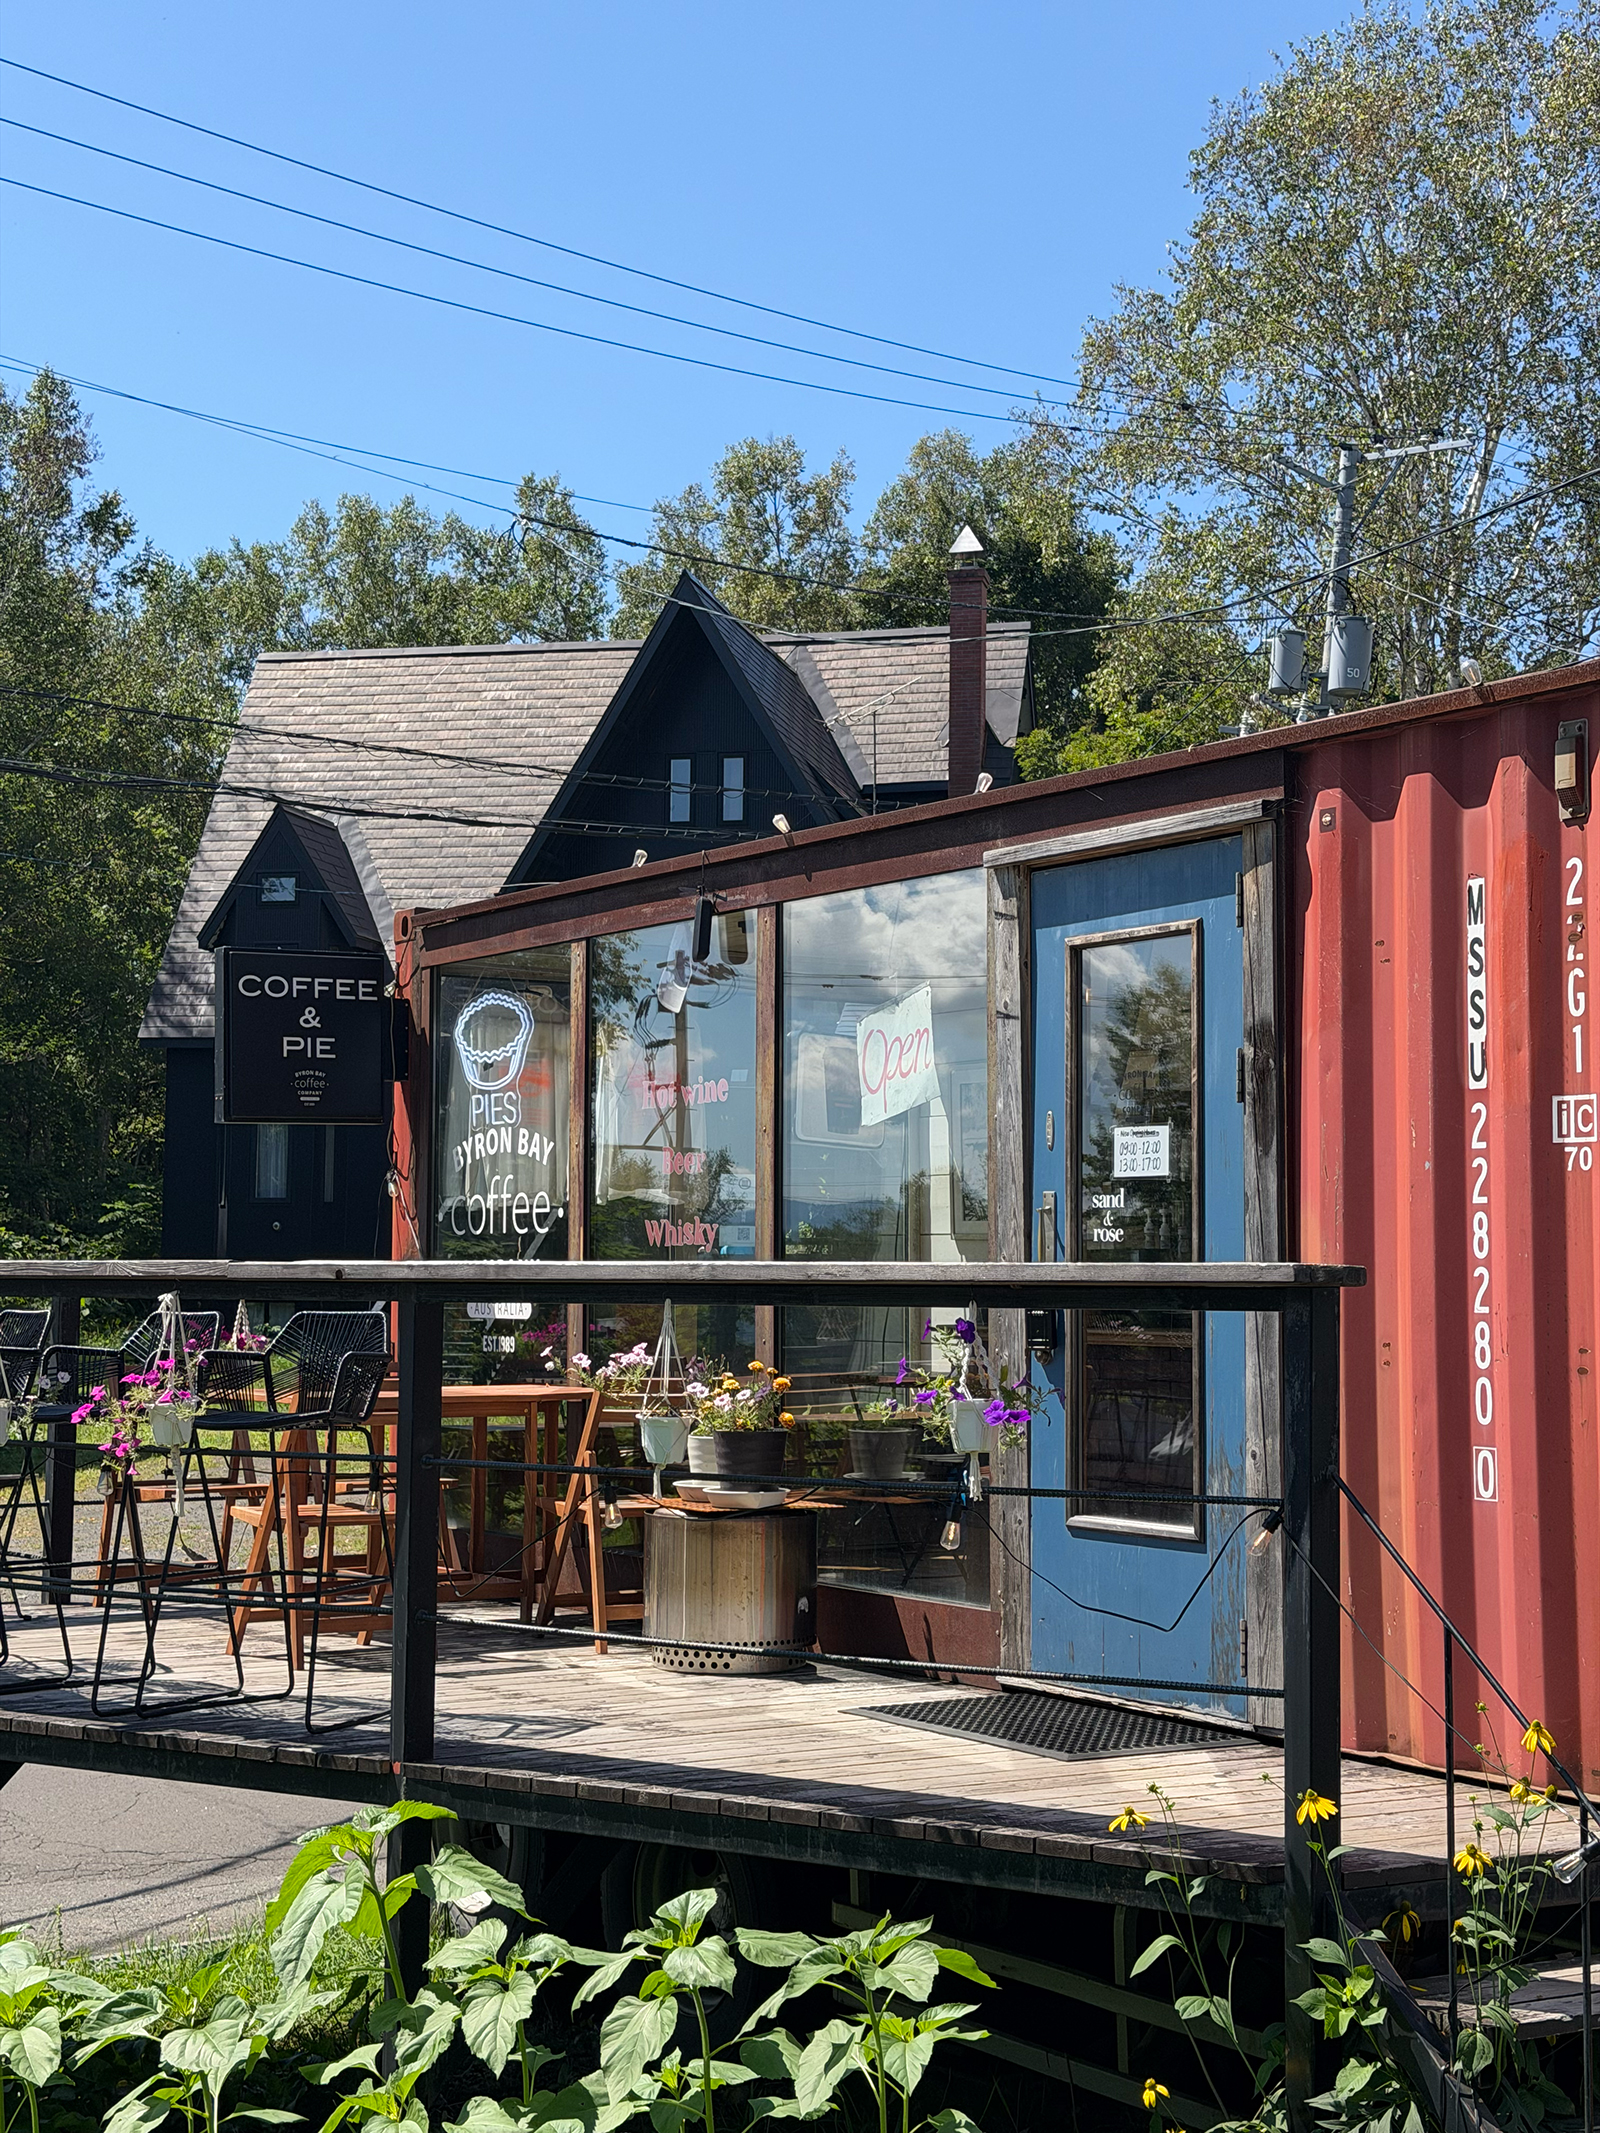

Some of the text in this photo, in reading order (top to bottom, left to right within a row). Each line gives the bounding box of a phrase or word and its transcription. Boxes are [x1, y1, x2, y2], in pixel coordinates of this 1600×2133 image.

[1346, 667, 1360, 678] 50
[238, 974, 378, 1001] COFFEE
[1467, 884, 1487, 1083] MSSU
[299, 1006, 322, 1028] &
[282, 1036, 336, 1058] PIE
[294, 1077, 326, 1088] coffee
[861, 1026, 932, 1114] Open
[641, 1075, 729, 1110] Hot wine
[470, 1091, 518, 1127] PIES
[452, 1127, 555, 1173] BYRON BAY
[661, 1146, 707, 1175] Beer
[1564, 1146, 1592, 1172] 70
[451, 1174, 551, 1236] coffee
[1092, 1188, 1125, 1208] sand
[1103, 1210, 1114, 1226] &
[644, 1216, 718, 1252] Whisky
[1093, 1228, 1124, 1243] rose
[1470, 1102, 1493, 1426] 228280
[474, 1302, 524, 1316] AUSRALIA
[482, 1335, 515, 1353] EST.1989
